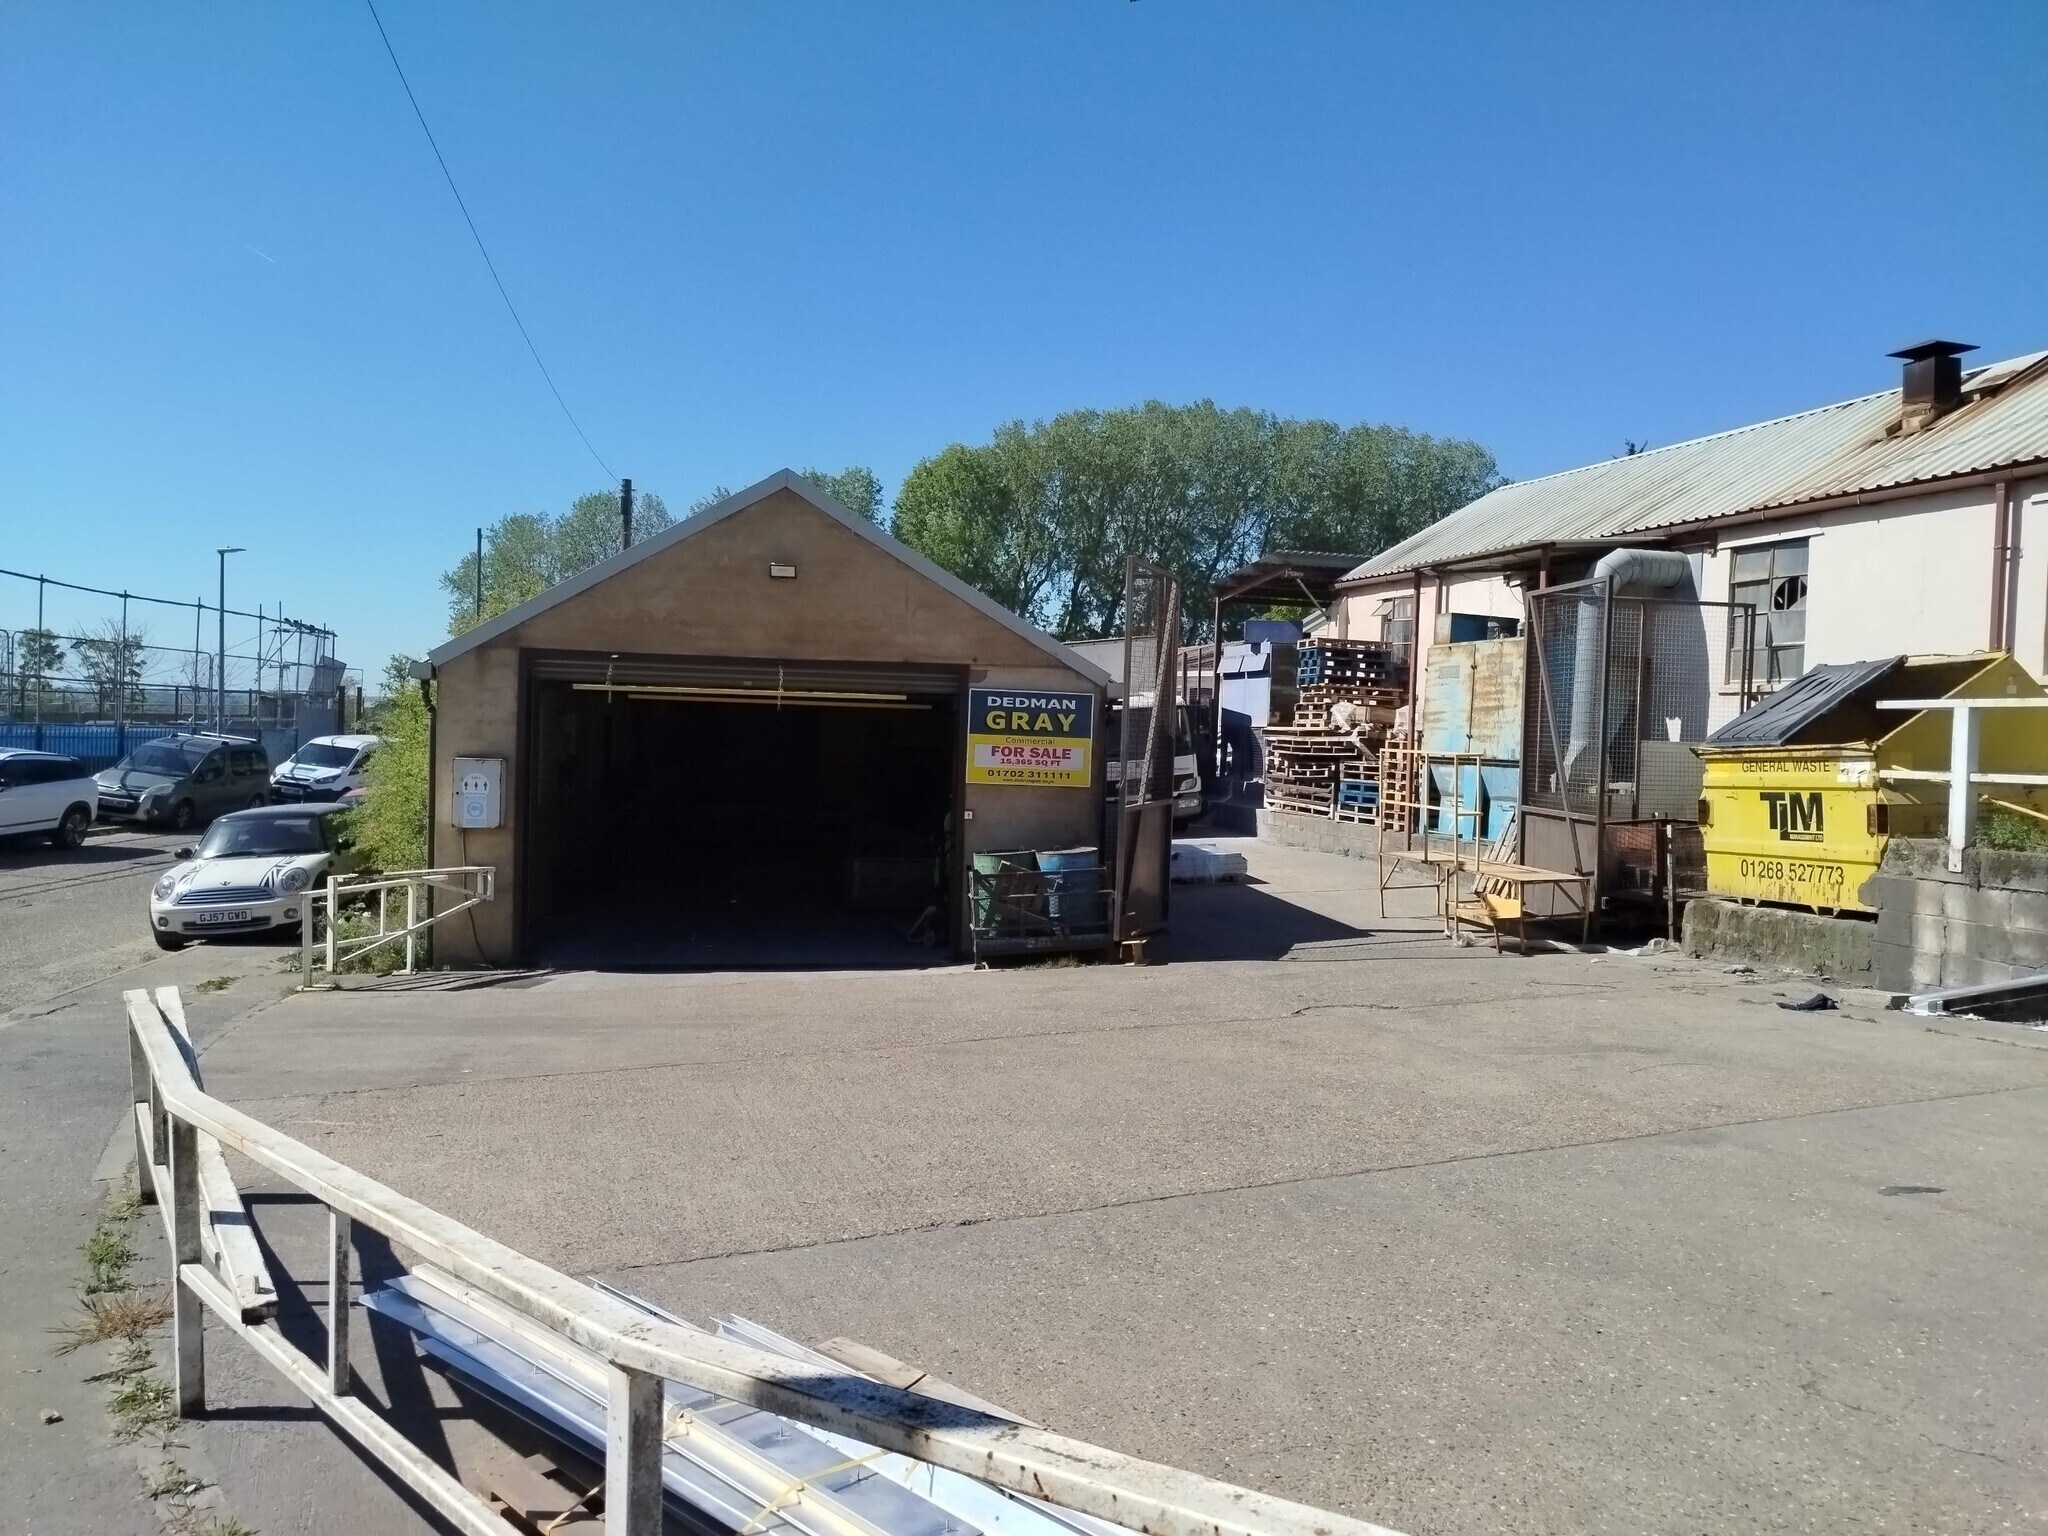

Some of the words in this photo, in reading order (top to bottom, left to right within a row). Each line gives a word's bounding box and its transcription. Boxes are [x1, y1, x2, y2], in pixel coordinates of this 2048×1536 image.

[987, 696, 1076, 710] DEDMAN
[986, 711, 1076, 732] GRAY
[1005, 737, 1055, 746] Commercial
[991, 746, 1025, 758] FOR
[1029, 747, 1072, 760] SALE
[1000, 758, 1033, 767] 15,365
[1741, 760, 1790, 773] GENERAL
[1792, 760, 1831, 773] WASTE
[987, 769, 1024, 778] 01702
[1027, 770, 1071, 779] 311111
[1741, 859, 1784, 880] 01268
[1788, 863, 1845, 886] 527773
[200, 912, 225, 923] GJ57
[228, 911, 247, 921] GWD
